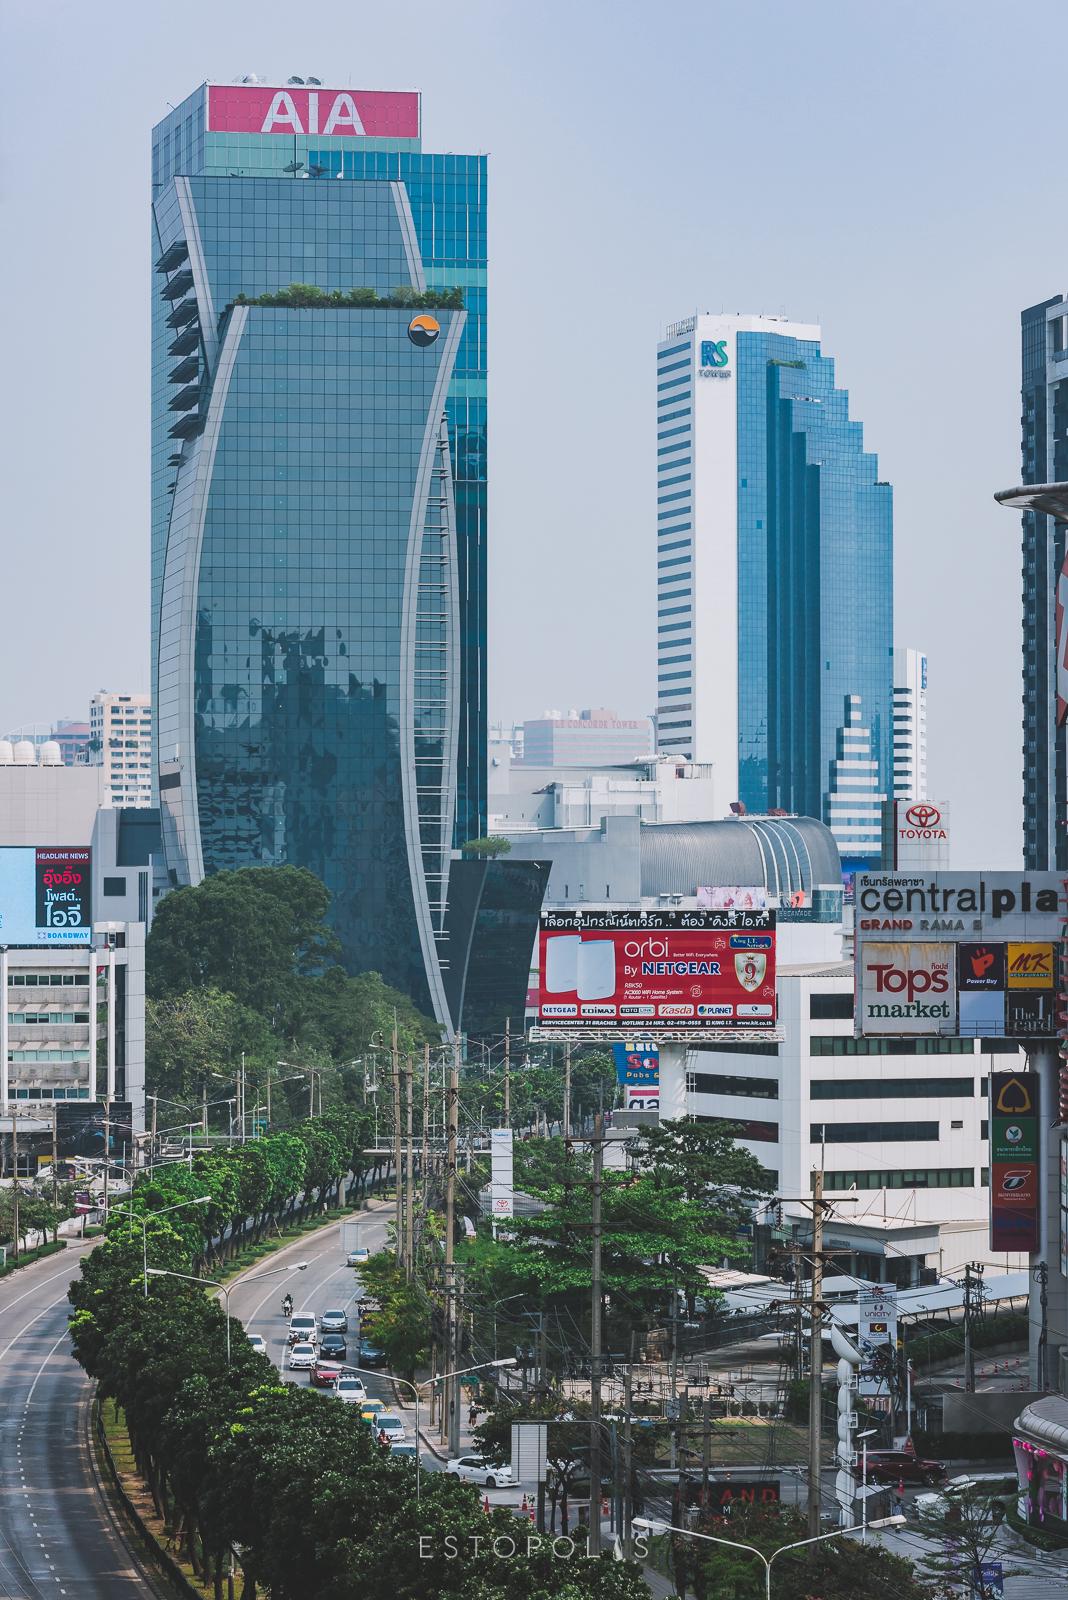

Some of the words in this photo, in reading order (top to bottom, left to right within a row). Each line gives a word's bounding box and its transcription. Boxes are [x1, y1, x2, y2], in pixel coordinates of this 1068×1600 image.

[261, 91, 366, 135] AIA
[701, 340, 728, 367] RS
[899, 829, 947, 839] TOYOTA
[44, 902, 82, 927] ไอจี
[860, 919, 913, 931] GRAND
[920, 919, 965, 931] RAMA
[624, 936, 669, 958] orbi
[624, 965, 638, 978] By
[641, 961, 722, 976] NETGEAR
[1009, 953, 1052, 972] MK
[866, 963, 950, 1003] Tops
[661, 1005, 692, 1015] Kasda
[707, 1006, 732, 1014] PLANET
[867, 1000, 950, 1019] market
[1012, 1007, 1035, 1020] The
[1014, 1013, 1051, 1031] card
